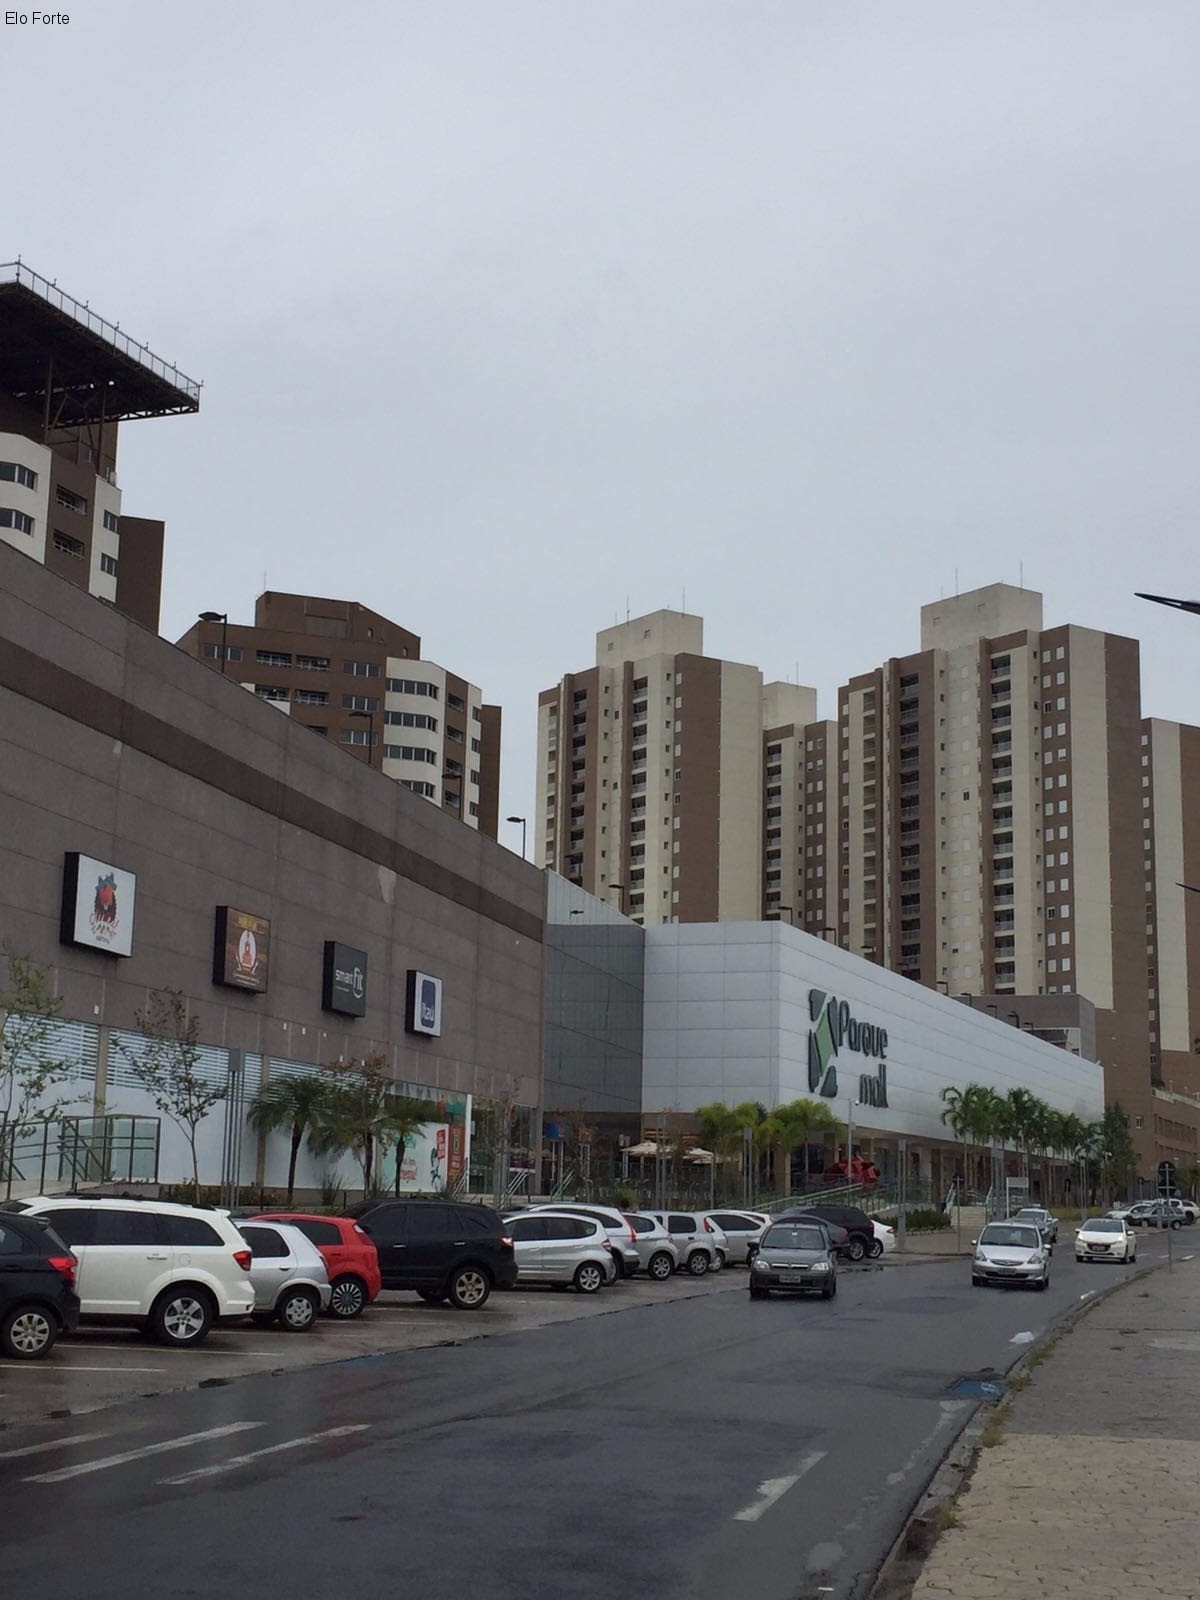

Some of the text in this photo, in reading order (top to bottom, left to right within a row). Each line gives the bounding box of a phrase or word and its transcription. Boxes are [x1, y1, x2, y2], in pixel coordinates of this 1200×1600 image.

[335, 969, 354, 985] smart
[838, 1000, 888, 1059] Parque
[859, 1063, 889, 1109] mall
